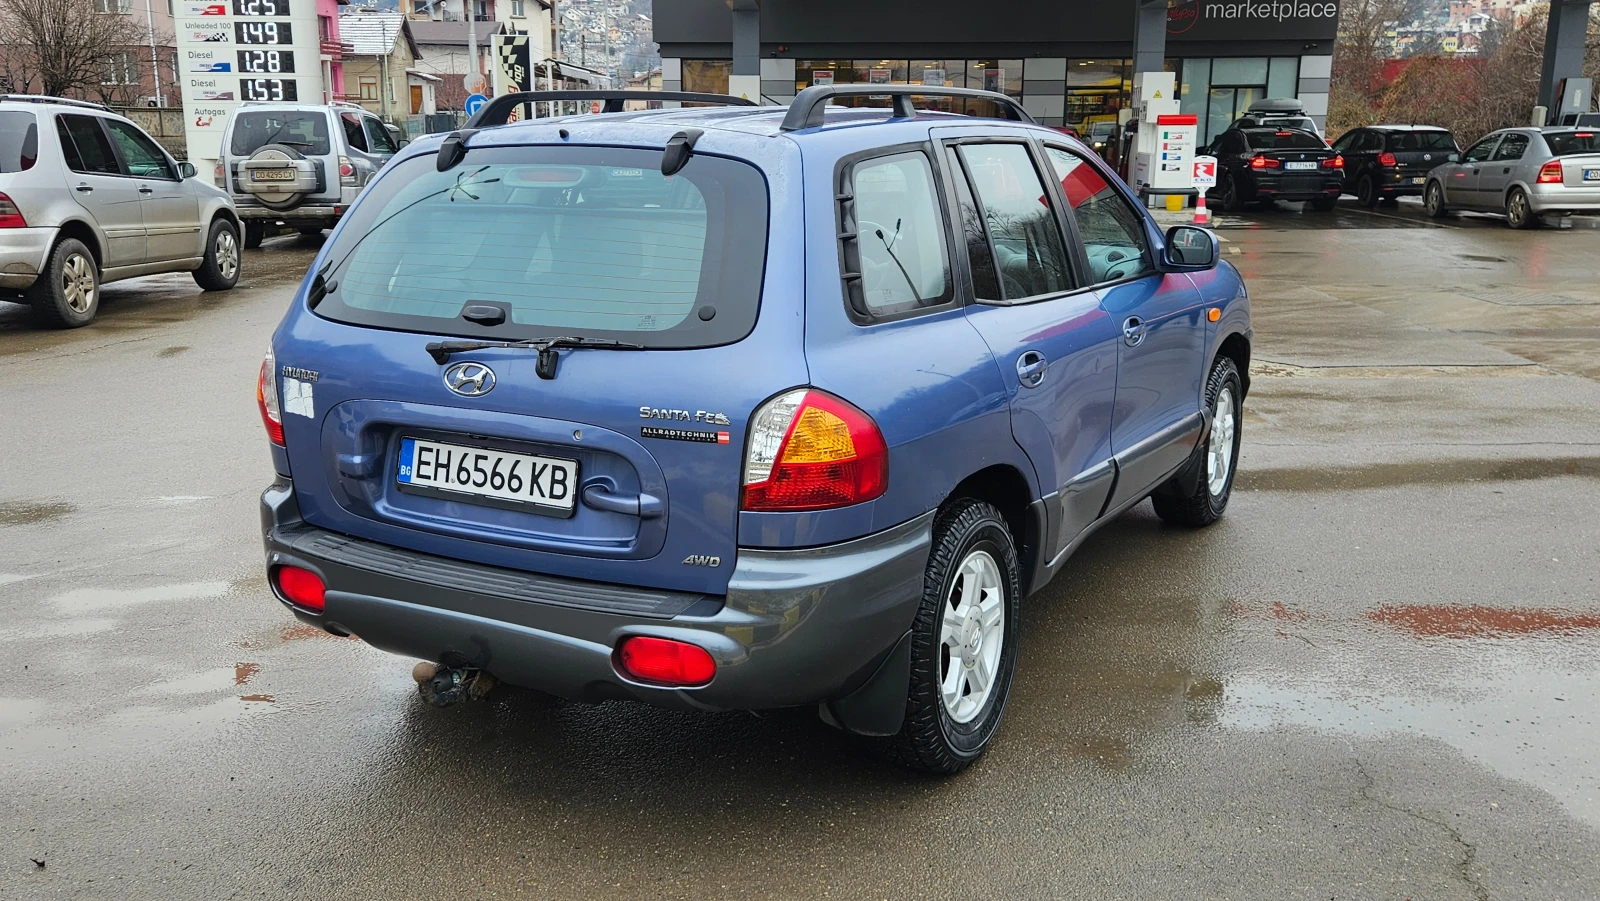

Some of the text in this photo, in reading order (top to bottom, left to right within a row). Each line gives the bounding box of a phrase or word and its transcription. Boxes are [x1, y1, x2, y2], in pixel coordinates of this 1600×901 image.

[240, 0, 276, 15] 1.25
[1205, 0, 1336, 22] marketplace
[242, 22, 279, 44] 1.49
[188, 51, 214, 59] Diesel
[245, 50, 281, 73] 1.28
[191, 79, 216, 88] Diesel
[248, 79, 284, 101] 1.53
[194, 107, 226, 118] Autogas
[282, 365, 319, 382] HYUNDAI
[639, 406, 715, 424] SANTA FE
[642, 428, 716, 439] ALLRADTECHNIK
[401, 465, 411, 476] BG
[415, 446, 568, 501] EH 6566 KB
[682, 553, 722, 568] 4WD
